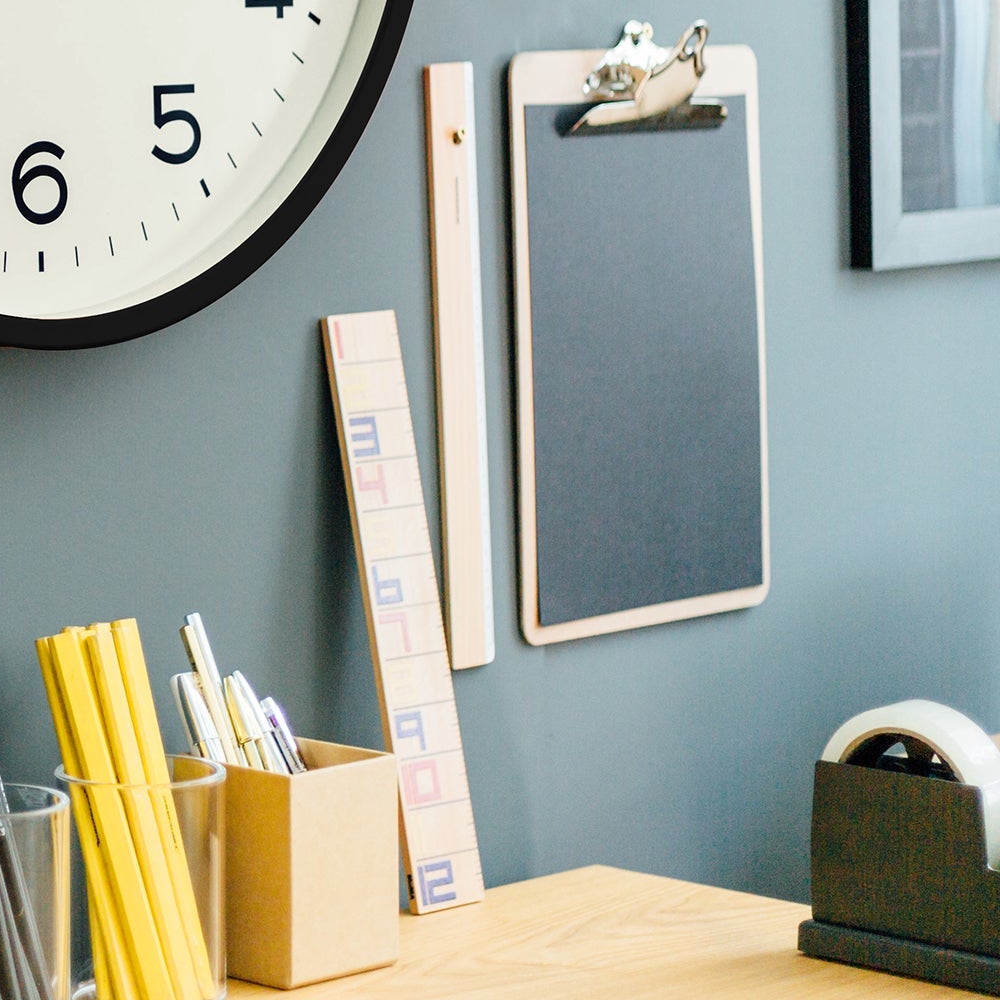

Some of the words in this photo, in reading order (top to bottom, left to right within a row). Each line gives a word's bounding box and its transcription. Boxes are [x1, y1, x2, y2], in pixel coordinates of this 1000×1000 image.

[151, 83, 202, 165] 5
[11, 140, 68, 226] 6
[348, 415, 381, 458] 3
[355, 463, 389, 506] 4
[371, 564, 404, 606] 6
[378, 611, 412, 653] 7
[393, 710, 427, 752] 9
[416, 859, 457, 907] 12
